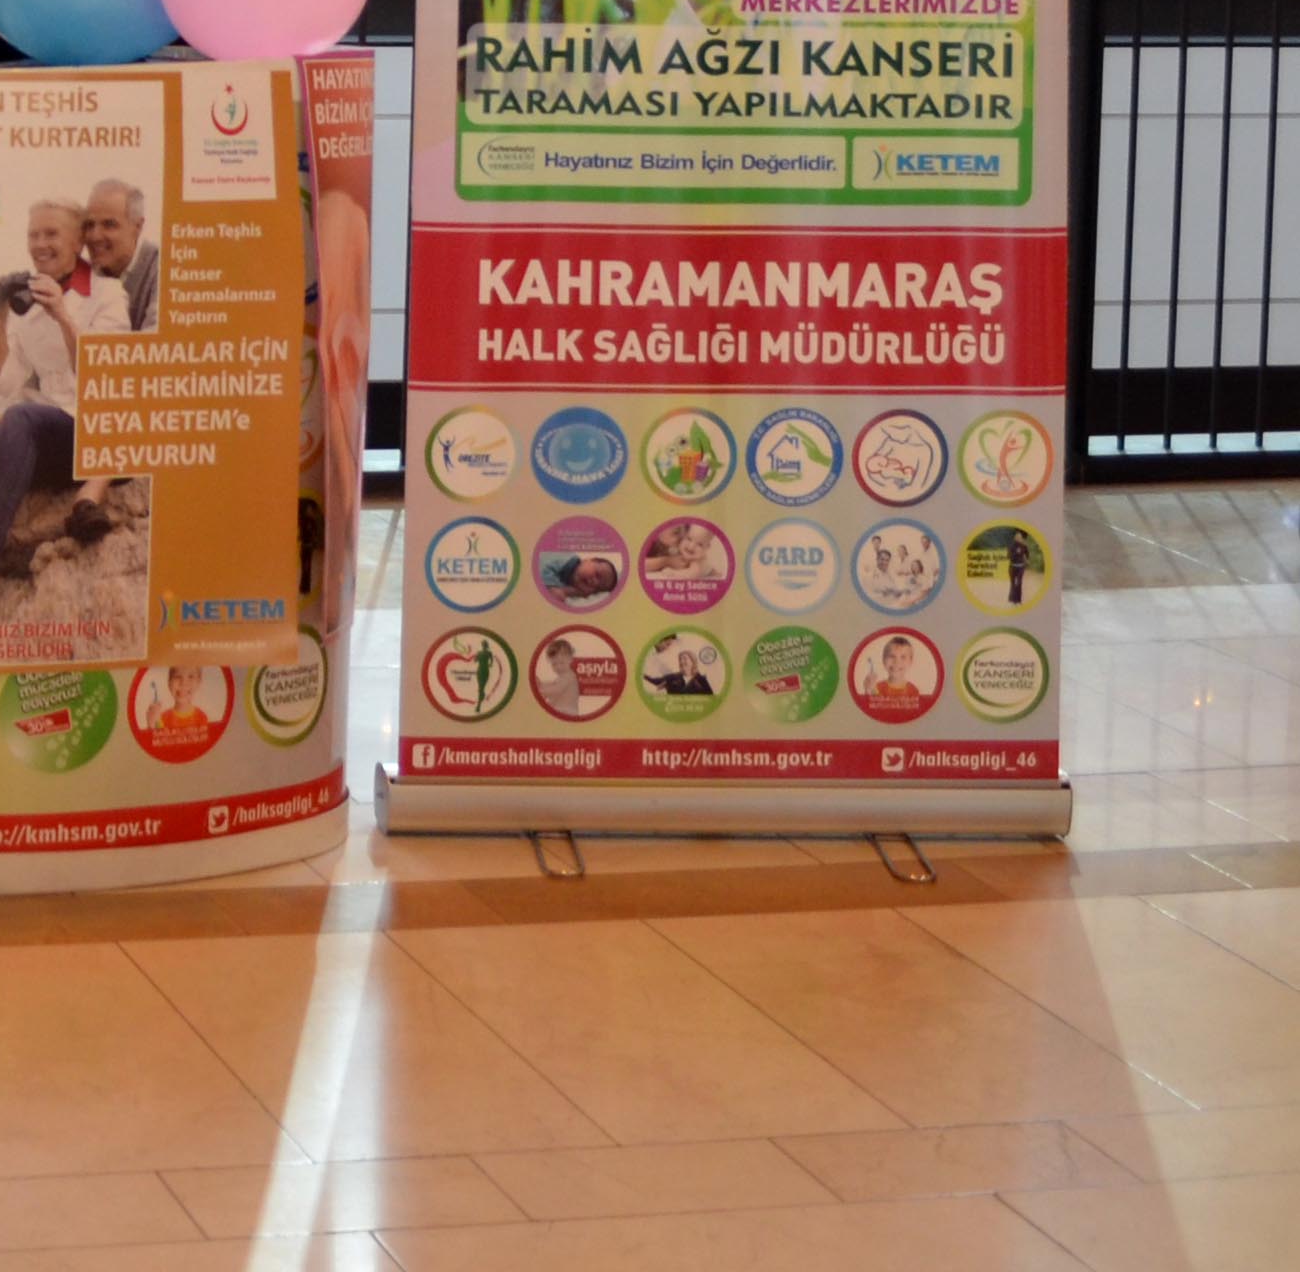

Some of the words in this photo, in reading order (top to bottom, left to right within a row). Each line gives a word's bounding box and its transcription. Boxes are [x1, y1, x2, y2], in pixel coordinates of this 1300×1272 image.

[474, 29, 644, 75] RAHİM
[659, 25, 780, 77] AĞZI
[802, 32, 1014, 79] KANSERİ
[11, 86, 98, 119] TEŞHİS
[475, 88, 678, 117] TARAMASI
[693, 92, 1013, 120] YAPILMAKTADIR
[543, 149, 634, 175] Hayatınız
[640, 151, 695, 172] Bizim
[701, 149, 735, 177] İçin
[741, 152, 838, 178] Değerlidir.
[896, 154, 1000, 174] KETEM
[170, 223, 215, 239] Erken
[217, 222, 263, 242] Teşhis
[170, 244, 198, 264] İçin
[169, 266, 223, 281] Kanser
[477, 259, 1004, 316] KAHRAMANMARAŞ
[84, 340, 234, 367] TARAMALAR
[239, 336, 290, 368] İÇİN
[477, 328, 583, 363] HALK
[592, 322, 748, 363] SAĞLIĞI
[760, 323, 1006, 365] MÜDÜRLÜĞÜ
[83, 373, 135, 401] AİLE
[140, 370, 284, 399] HEKİMİNİZE
[82, 411, 144, 435] VEYA
[150, 407, 251, 432] KETEM'e
[81, 443, 217, 473] BAŞVURUN
[436, 557, 509, 575] KETEM
[759, 547, 825, 565] GARD
[182, 598, 285, 621] KETEM
[438, 742, 602, 768] /kmarashalksagligi
[641, 747, 833, 769] http://kmhsm.gov.tr
[908, 751, 1038, 772] /halksagligi_46
